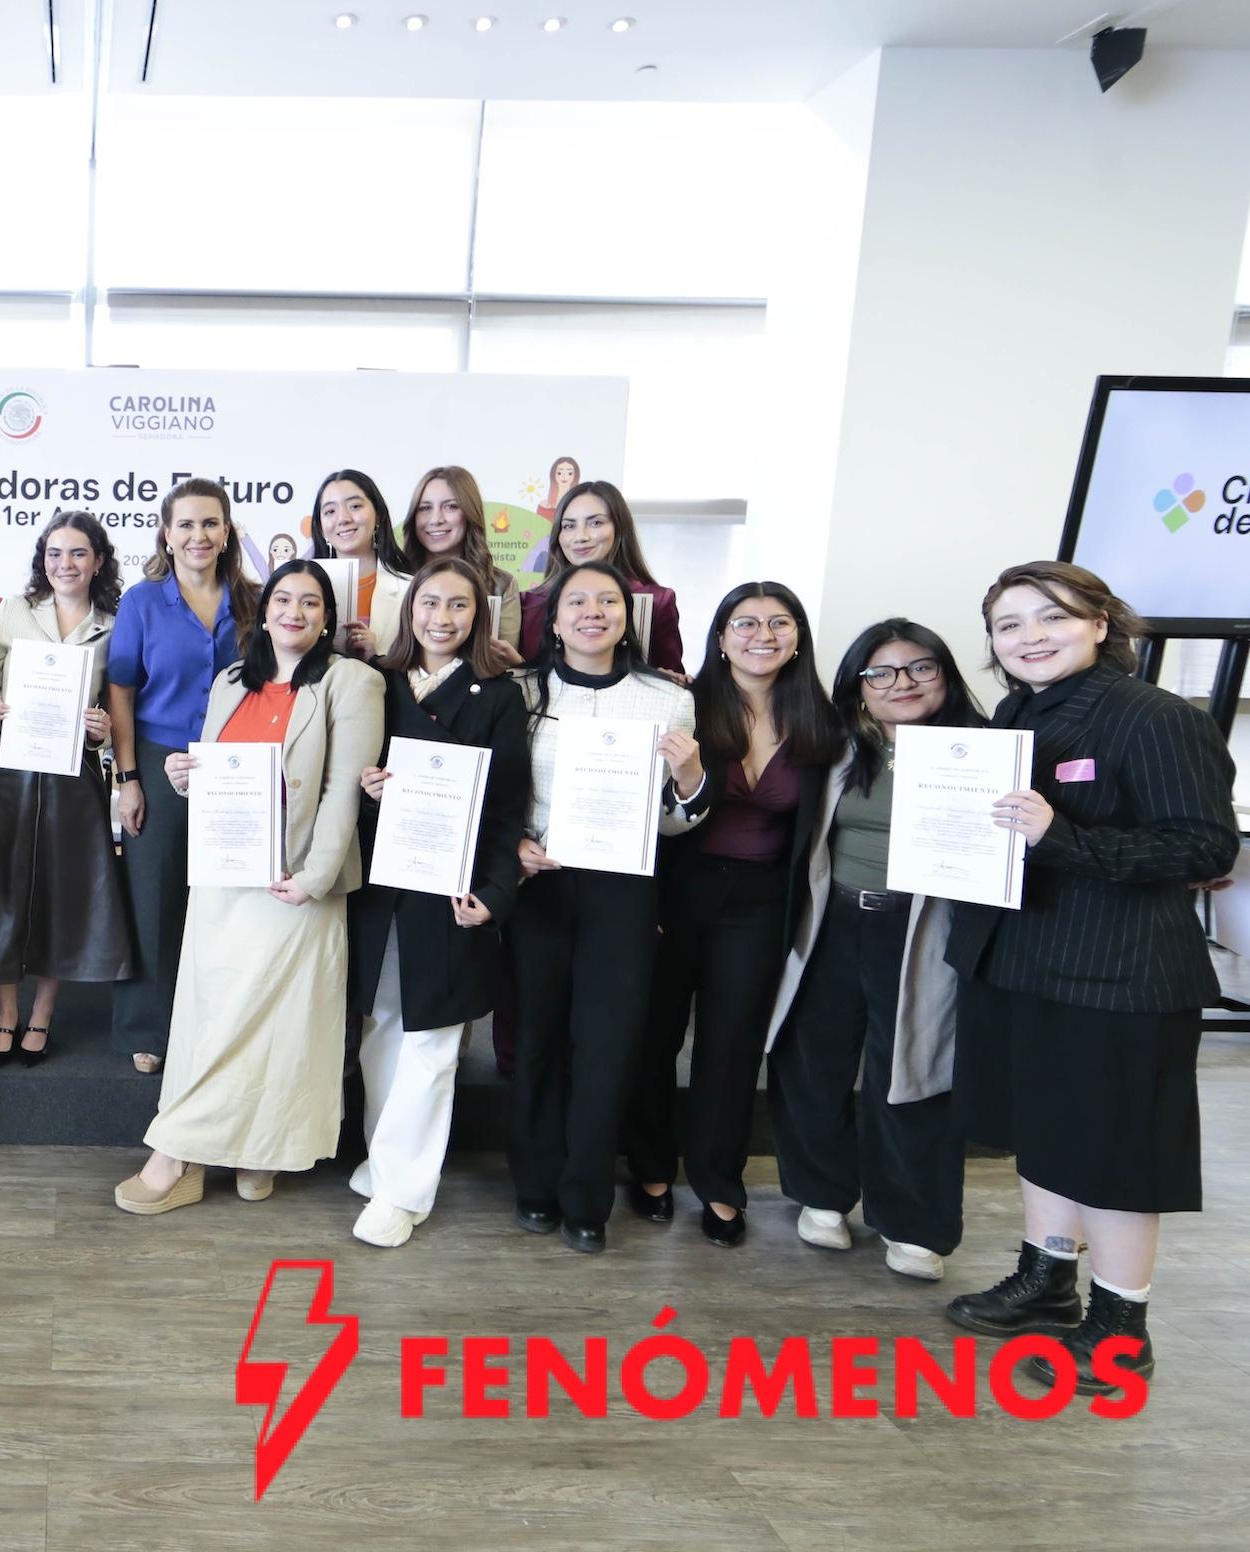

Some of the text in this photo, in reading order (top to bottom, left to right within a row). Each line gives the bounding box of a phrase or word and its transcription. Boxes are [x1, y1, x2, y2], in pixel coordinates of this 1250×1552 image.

[109, 396, 216, 413] CAROLINA
[111, 415, 214, 431] VIGGIANO
[113, 471, 158, 501] de
[3, 505, 41, 526] 1er
[918, 783, 999, 794] RECONOCIMIENTO
